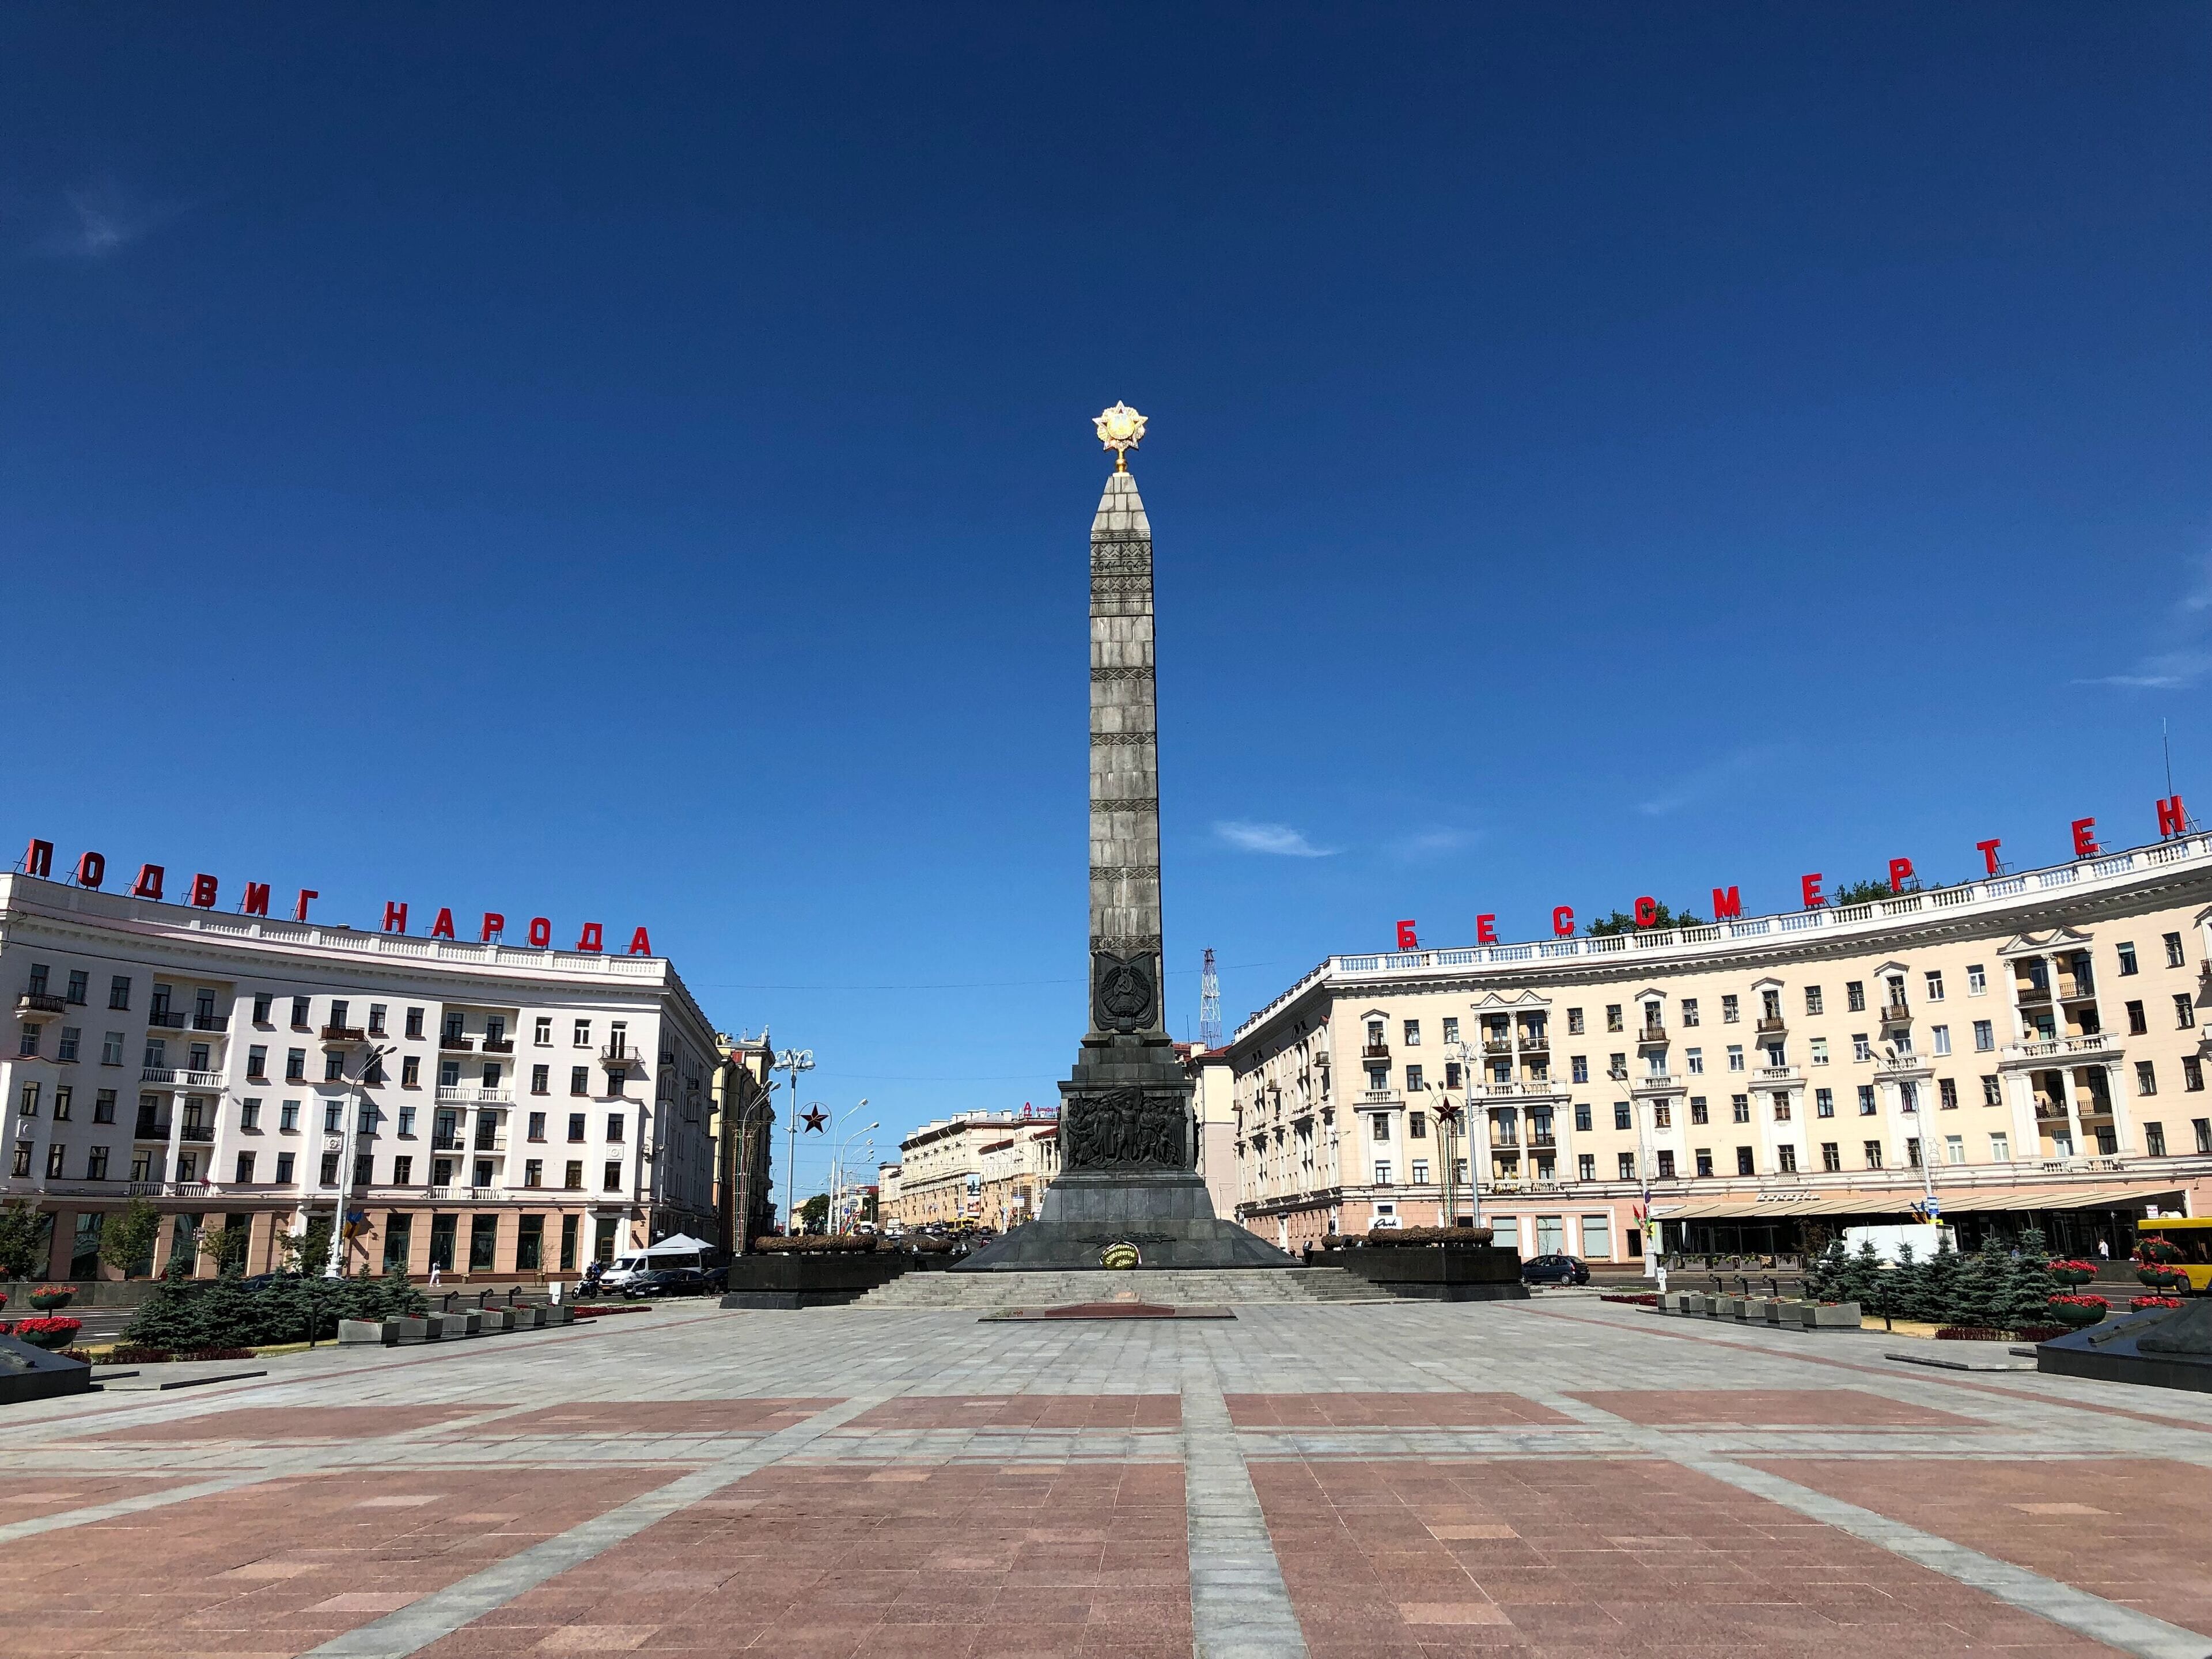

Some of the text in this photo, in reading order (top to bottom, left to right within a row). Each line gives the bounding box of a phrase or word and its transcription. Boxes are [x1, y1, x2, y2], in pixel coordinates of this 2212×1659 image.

[26, 838, 652, 956] ПОДВИГ НАРОДА
[1396, 795, 2187, 949] БЕССМЕРТЕН
